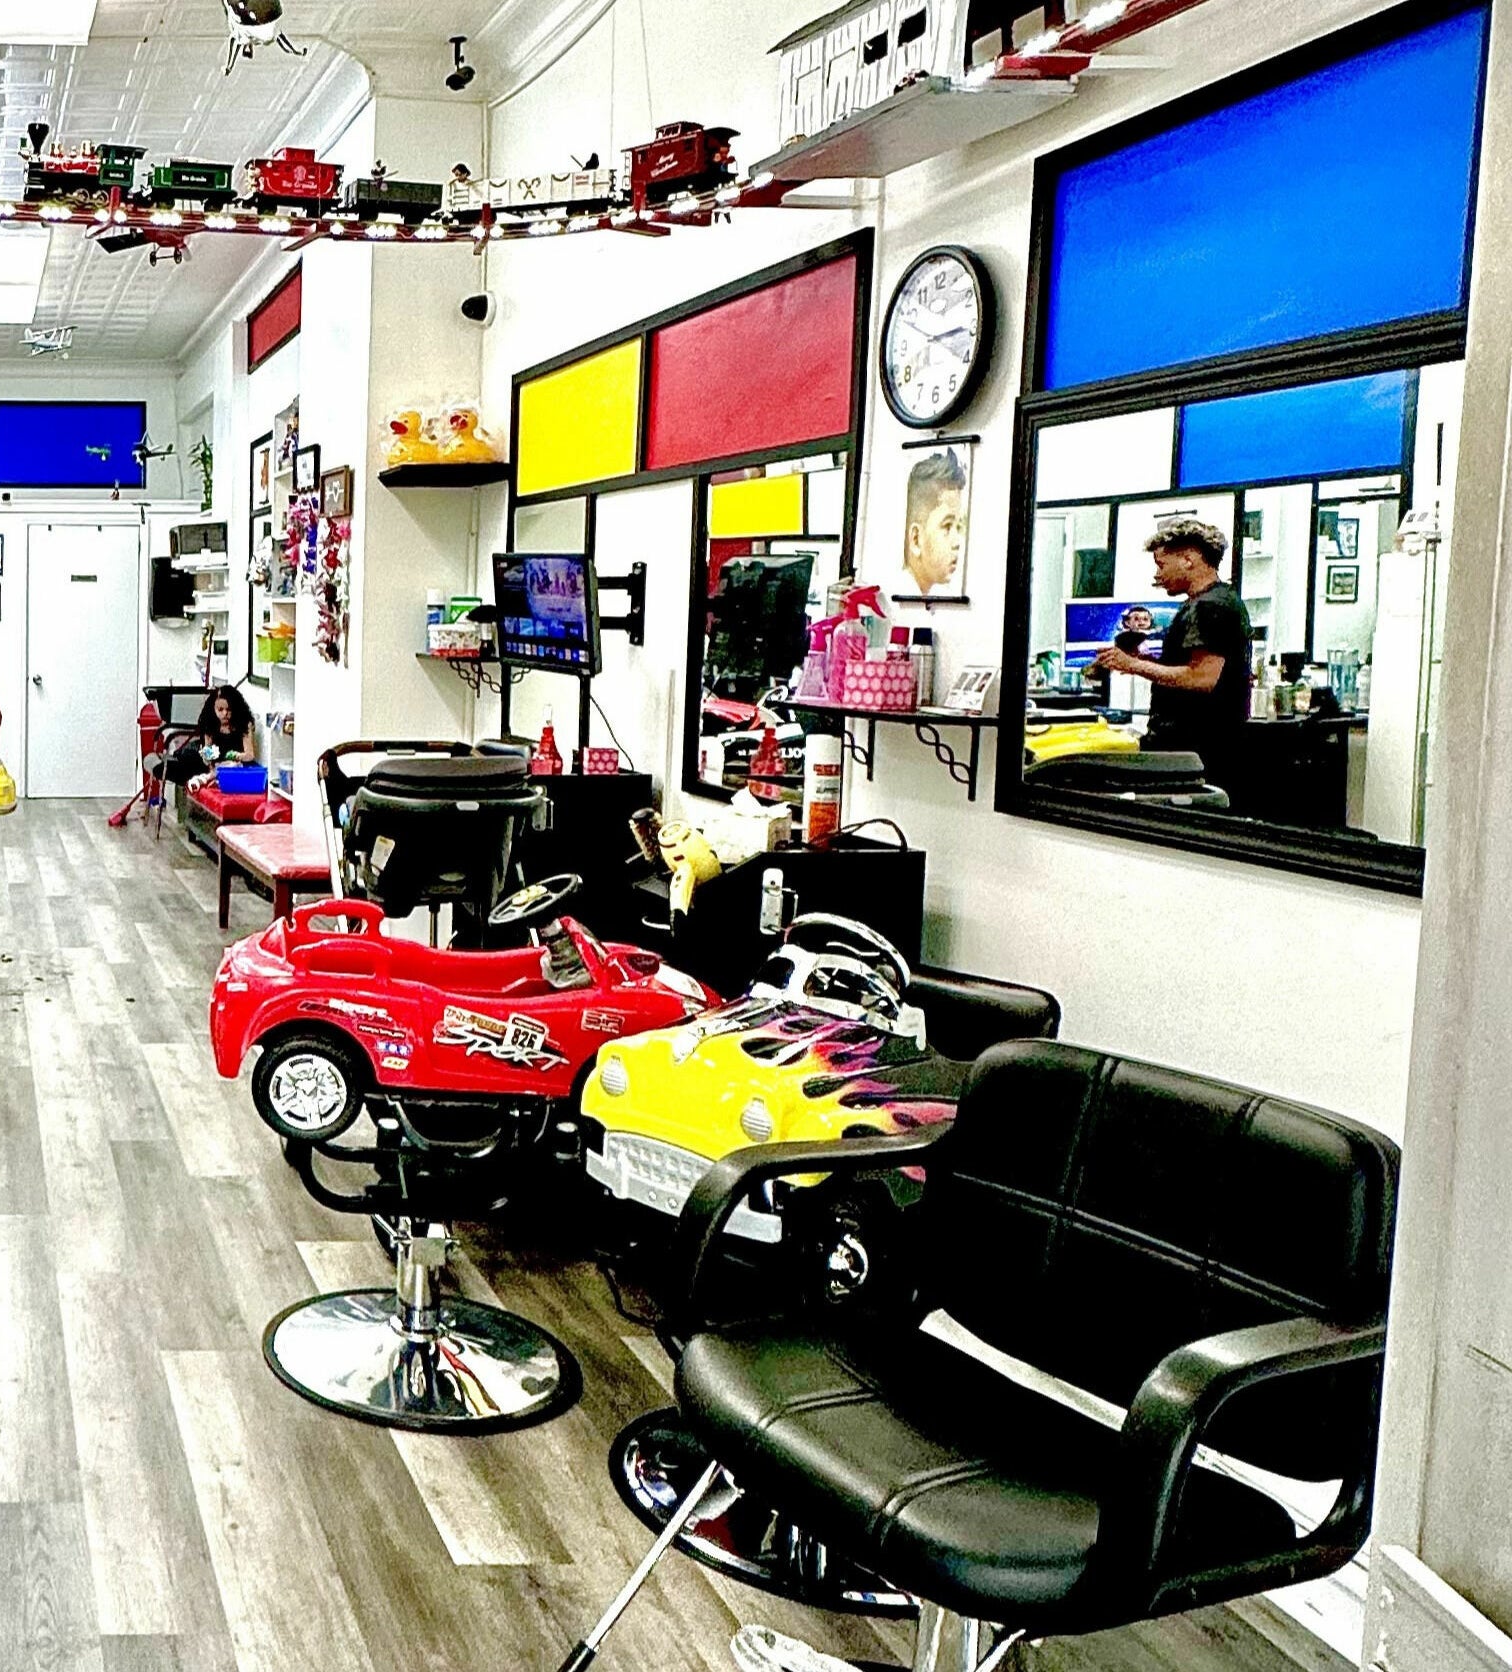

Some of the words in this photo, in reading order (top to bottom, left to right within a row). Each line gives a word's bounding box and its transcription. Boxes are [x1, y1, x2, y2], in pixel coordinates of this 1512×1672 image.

[282, 180, 293, 188] Rio
[294, 180, 318, 189] Grande
[934, 271, 946, 290] 12
[917, 286, 928, 305] 11
[965, 290, 974, 308] 2
[962, 348, 970, 364] 4
[903, 365, 912, 383] 8
[948, 374, 957, 392] 5
[916, 383, 924, 401] 7
[931, 386, 940, 404] 6
[510, 1028, 538, 1051] 826
